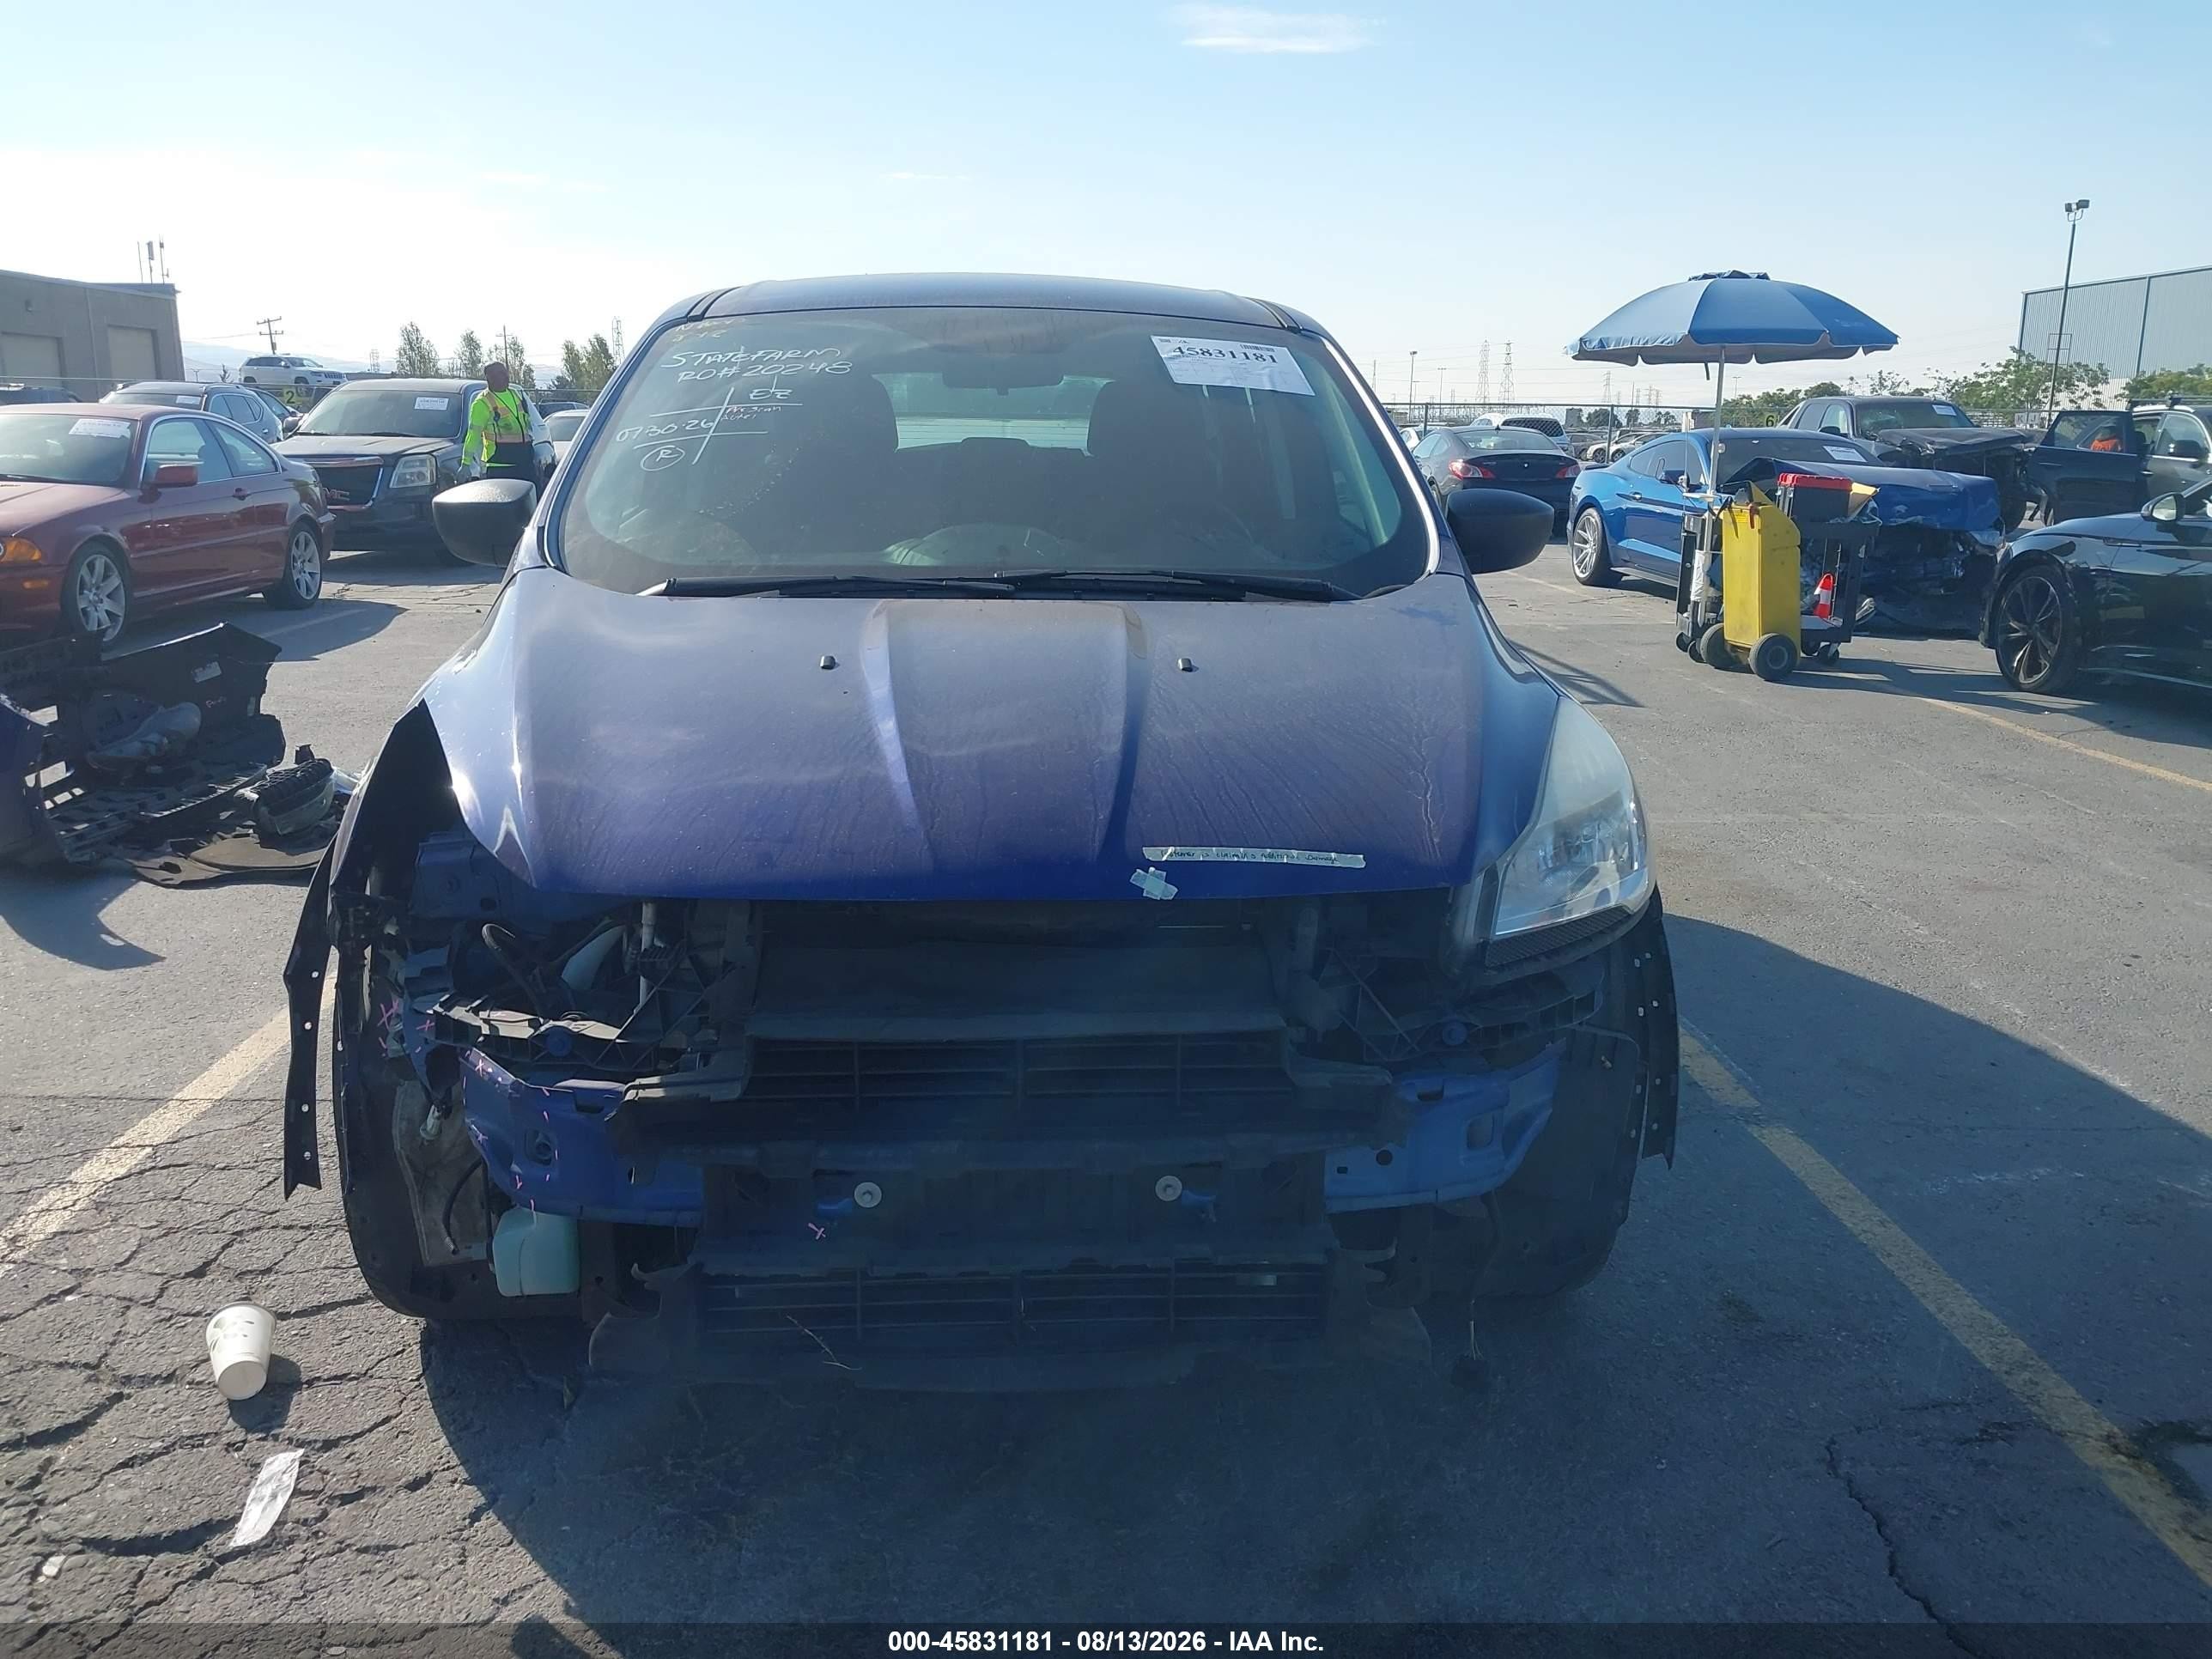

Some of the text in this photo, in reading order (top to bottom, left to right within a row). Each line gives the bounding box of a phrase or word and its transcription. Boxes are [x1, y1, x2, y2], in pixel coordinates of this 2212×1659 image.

[1173, 346, 1279, 364] 45831181
[285, 390, 296, 404] 2
[1765, 415, 1775, 428] 6
